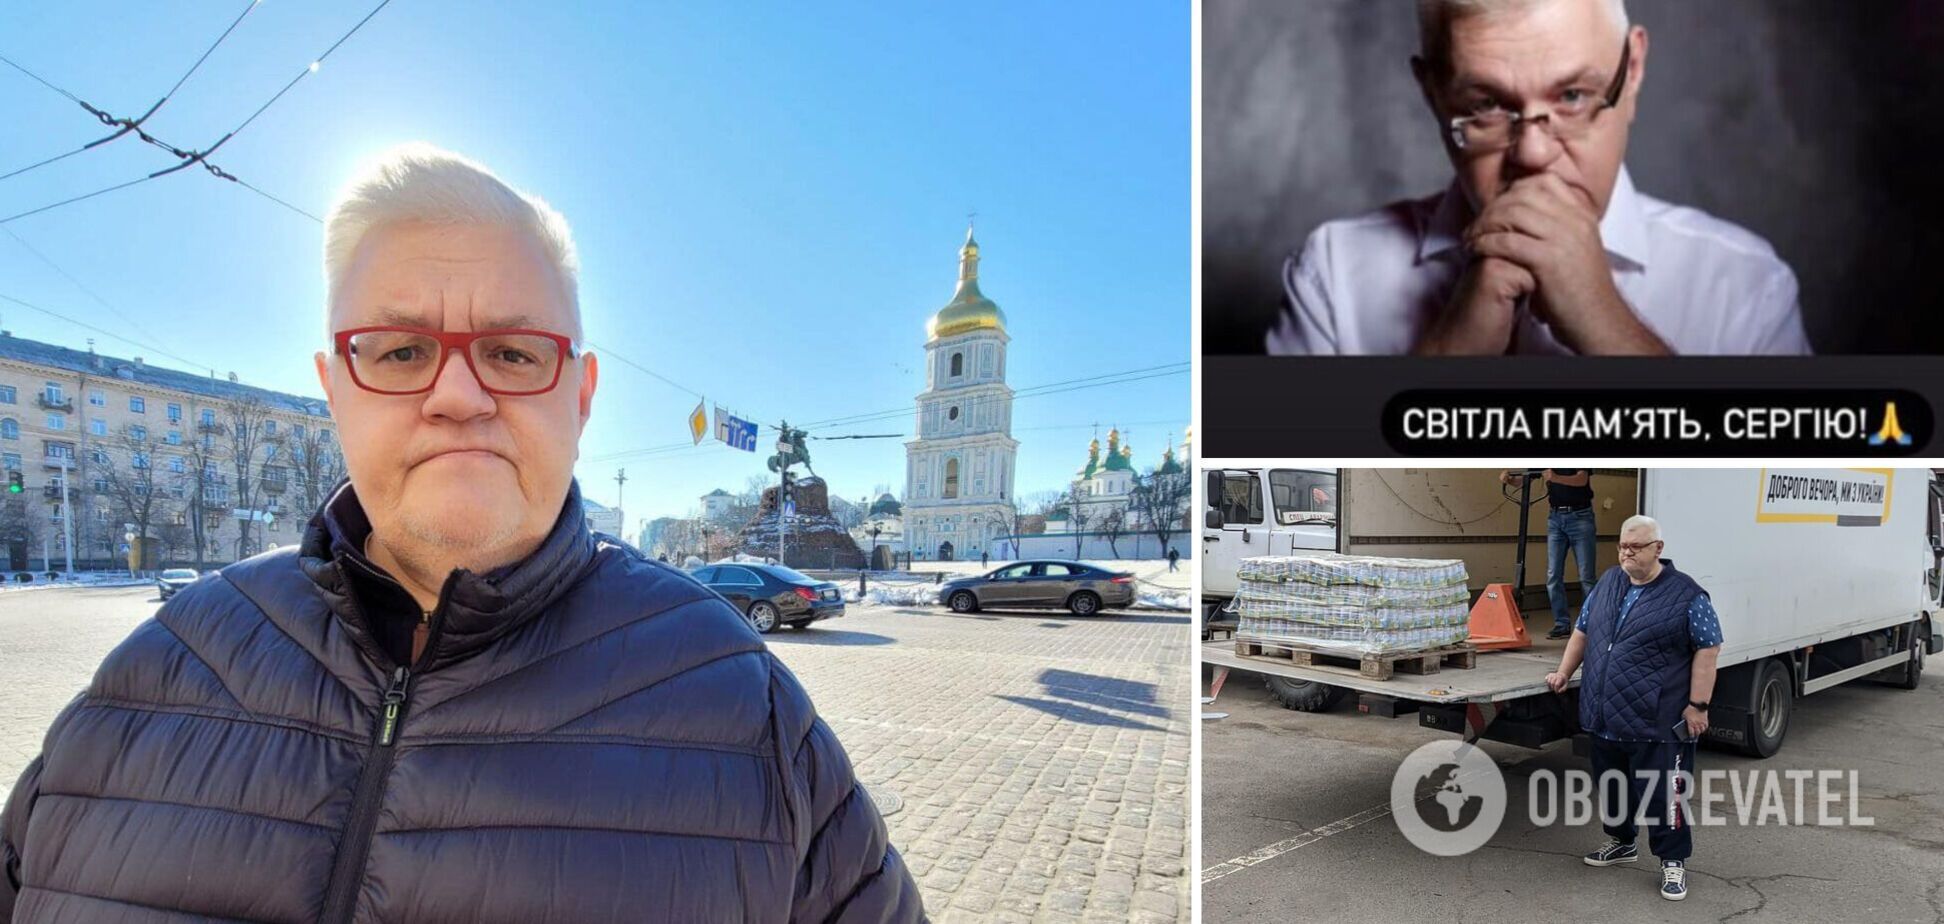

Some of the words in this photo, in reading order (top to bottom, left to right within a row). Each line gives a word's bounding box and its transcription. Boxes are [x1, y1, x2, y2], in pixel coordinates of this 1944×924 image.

[1766, 474, 1808, 503] ДОБРОГО
[1809, 478, 1839, 505] ВЕЧОРА,
[1840, 481, 1852, 502] МИ
